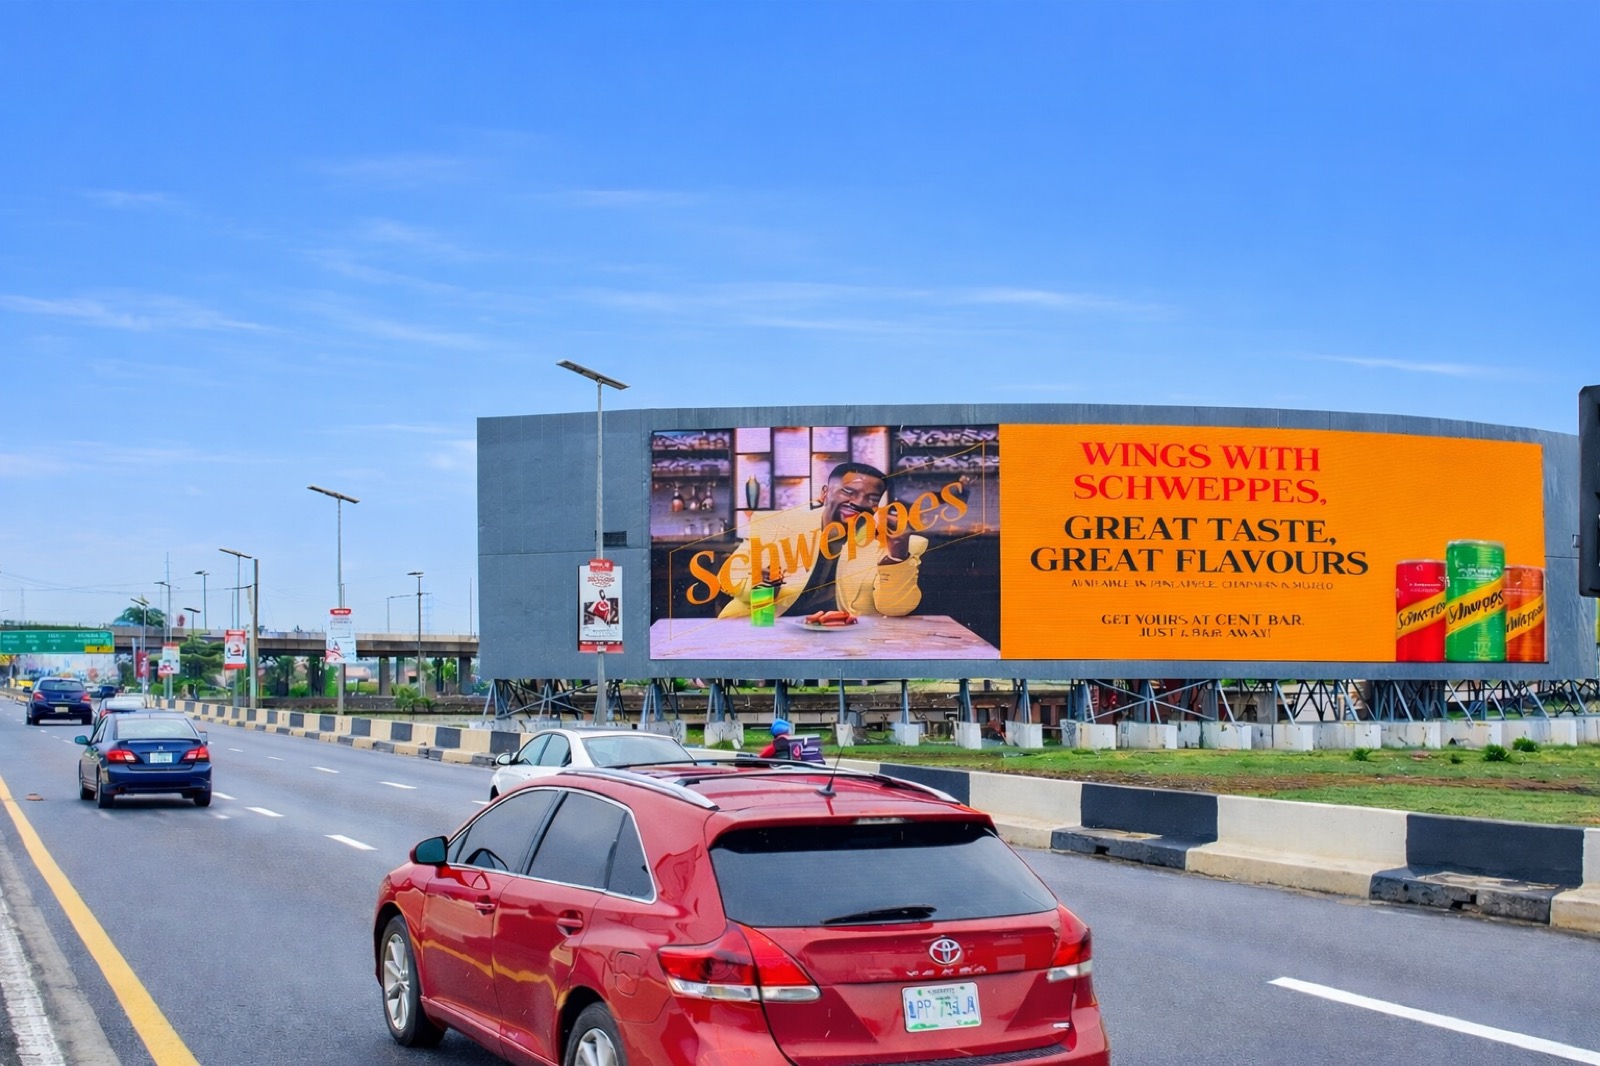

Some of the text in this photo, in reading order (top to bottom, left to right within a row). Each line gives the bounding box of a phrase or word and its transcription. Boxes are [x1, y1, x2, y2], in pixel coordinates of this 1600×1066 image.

[1079, 441, 1321, 472] WINGS WITH
[1073, 474, 1327, 506] SCHWEPPES,
[685, 481, 969, 606] Schweppes
[1063, 514, 1337, 546] GREAT TASTE,
[1029, 546, 1370, 576] GREAT FLAVOURS
[1101, 613, 1131, 625] GET
[1135, 613, 1189, 626] YOURS
[1192, 614, 1211, 626] AT
[1215, 613, 1262, 626] CENT
[1138, 627, 1178, 638] JUST
